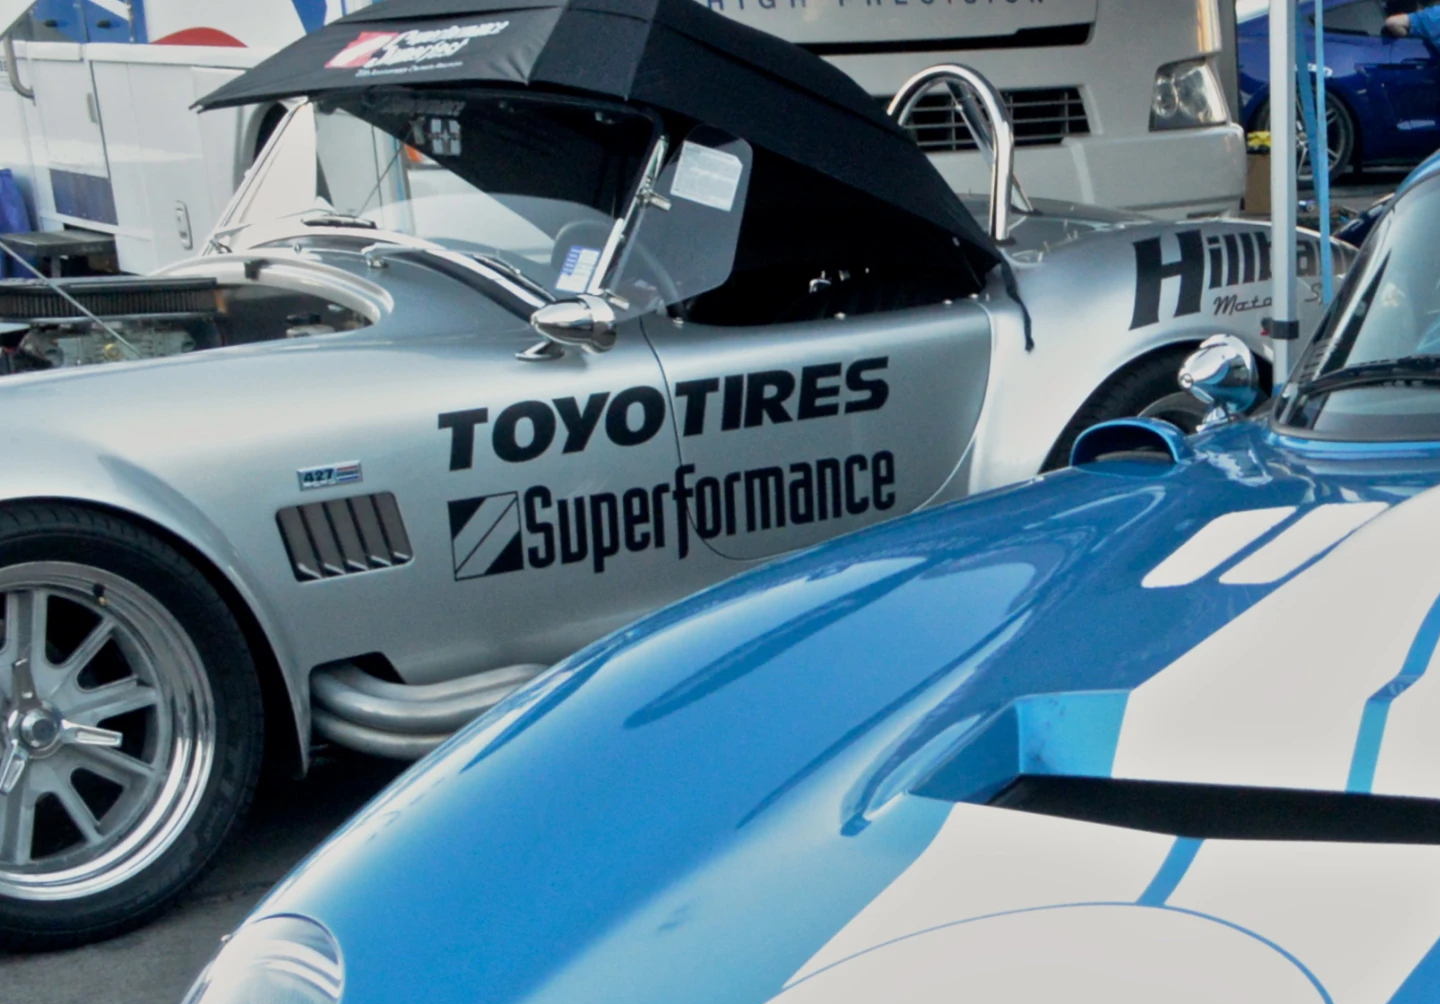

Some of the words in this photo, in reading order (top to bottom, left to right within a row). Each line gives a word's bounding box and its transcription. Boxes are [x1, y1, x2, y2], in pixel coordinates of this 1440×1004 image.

[437, 385, 666, 472] TOYO
[674, 355, 890, 438] TIRES
[303, 468, 335, 482] 427
[523, 450, 896, 574] Superformance
